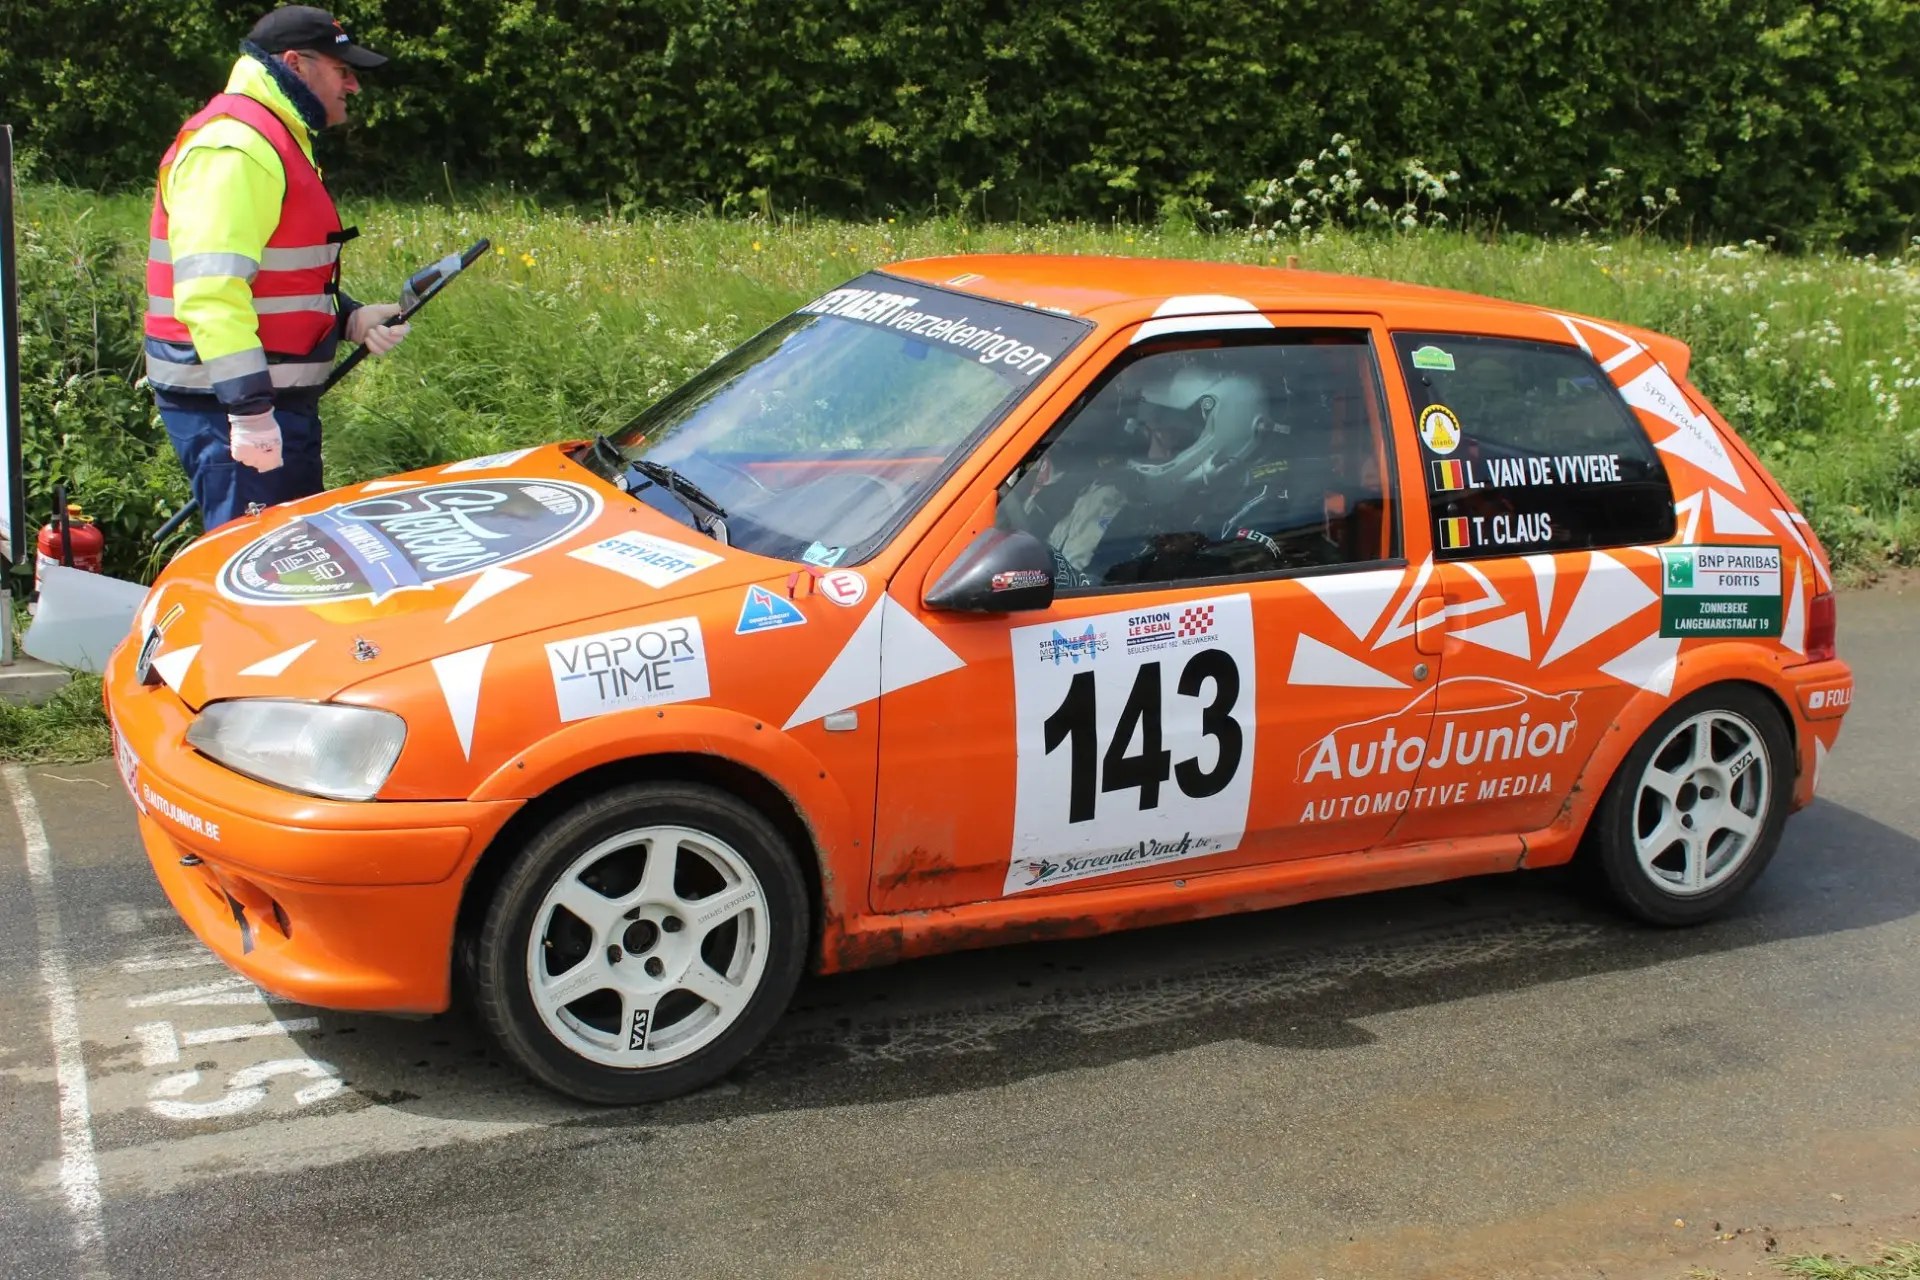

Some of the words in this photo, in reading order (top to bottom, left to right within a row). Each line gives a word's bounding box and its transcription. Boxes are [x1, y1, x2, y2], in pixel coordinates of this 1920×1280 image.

[1466, 460, 1485, 489] L.
[1487, 457, 1526, 488] VAN
[1528, 456, 1553, 486] DE
[1554, 454, 1622, 484] VYVERE
[336, 489, 513, 572] Stevens
[1472, 516, 1489, 546] T.
[1493, 512, 1552, 545] CLAUS
[597, 539, 697, 574] STEYAERT
[1698, 555, 1725, 568] BNP
[1728, 556, 1778, 569] PARIBAS
[831, 576, 867, 597] E
[1719, 575, 1760, 587] FORTIS
[1128, 612, 1170, 627] STATION
[1700, 602, 1748, 614] ZONNEBEKE
[1129, 626, 1141, 636] LE
[1144, 622, 1172, 634] SEAU
[1675, 618, 1757, 630] LANGEMARKSTRAAT
[1760, 618, 1769, 630] 19
[555, 627, 694, 673] VAPOR
[1039, 638, 1068, 648] STATION
[589, 660, 675, 700] TIME
[1044, 648, 1243, 824] 143
[1730, 753, 1754, 777] SVA
[1300, 782, 1468, 824] AUTOMOTIVE
[1477, 772, 1552, 801] MEDIA
[632, 1011, 647, 1049] SVA
